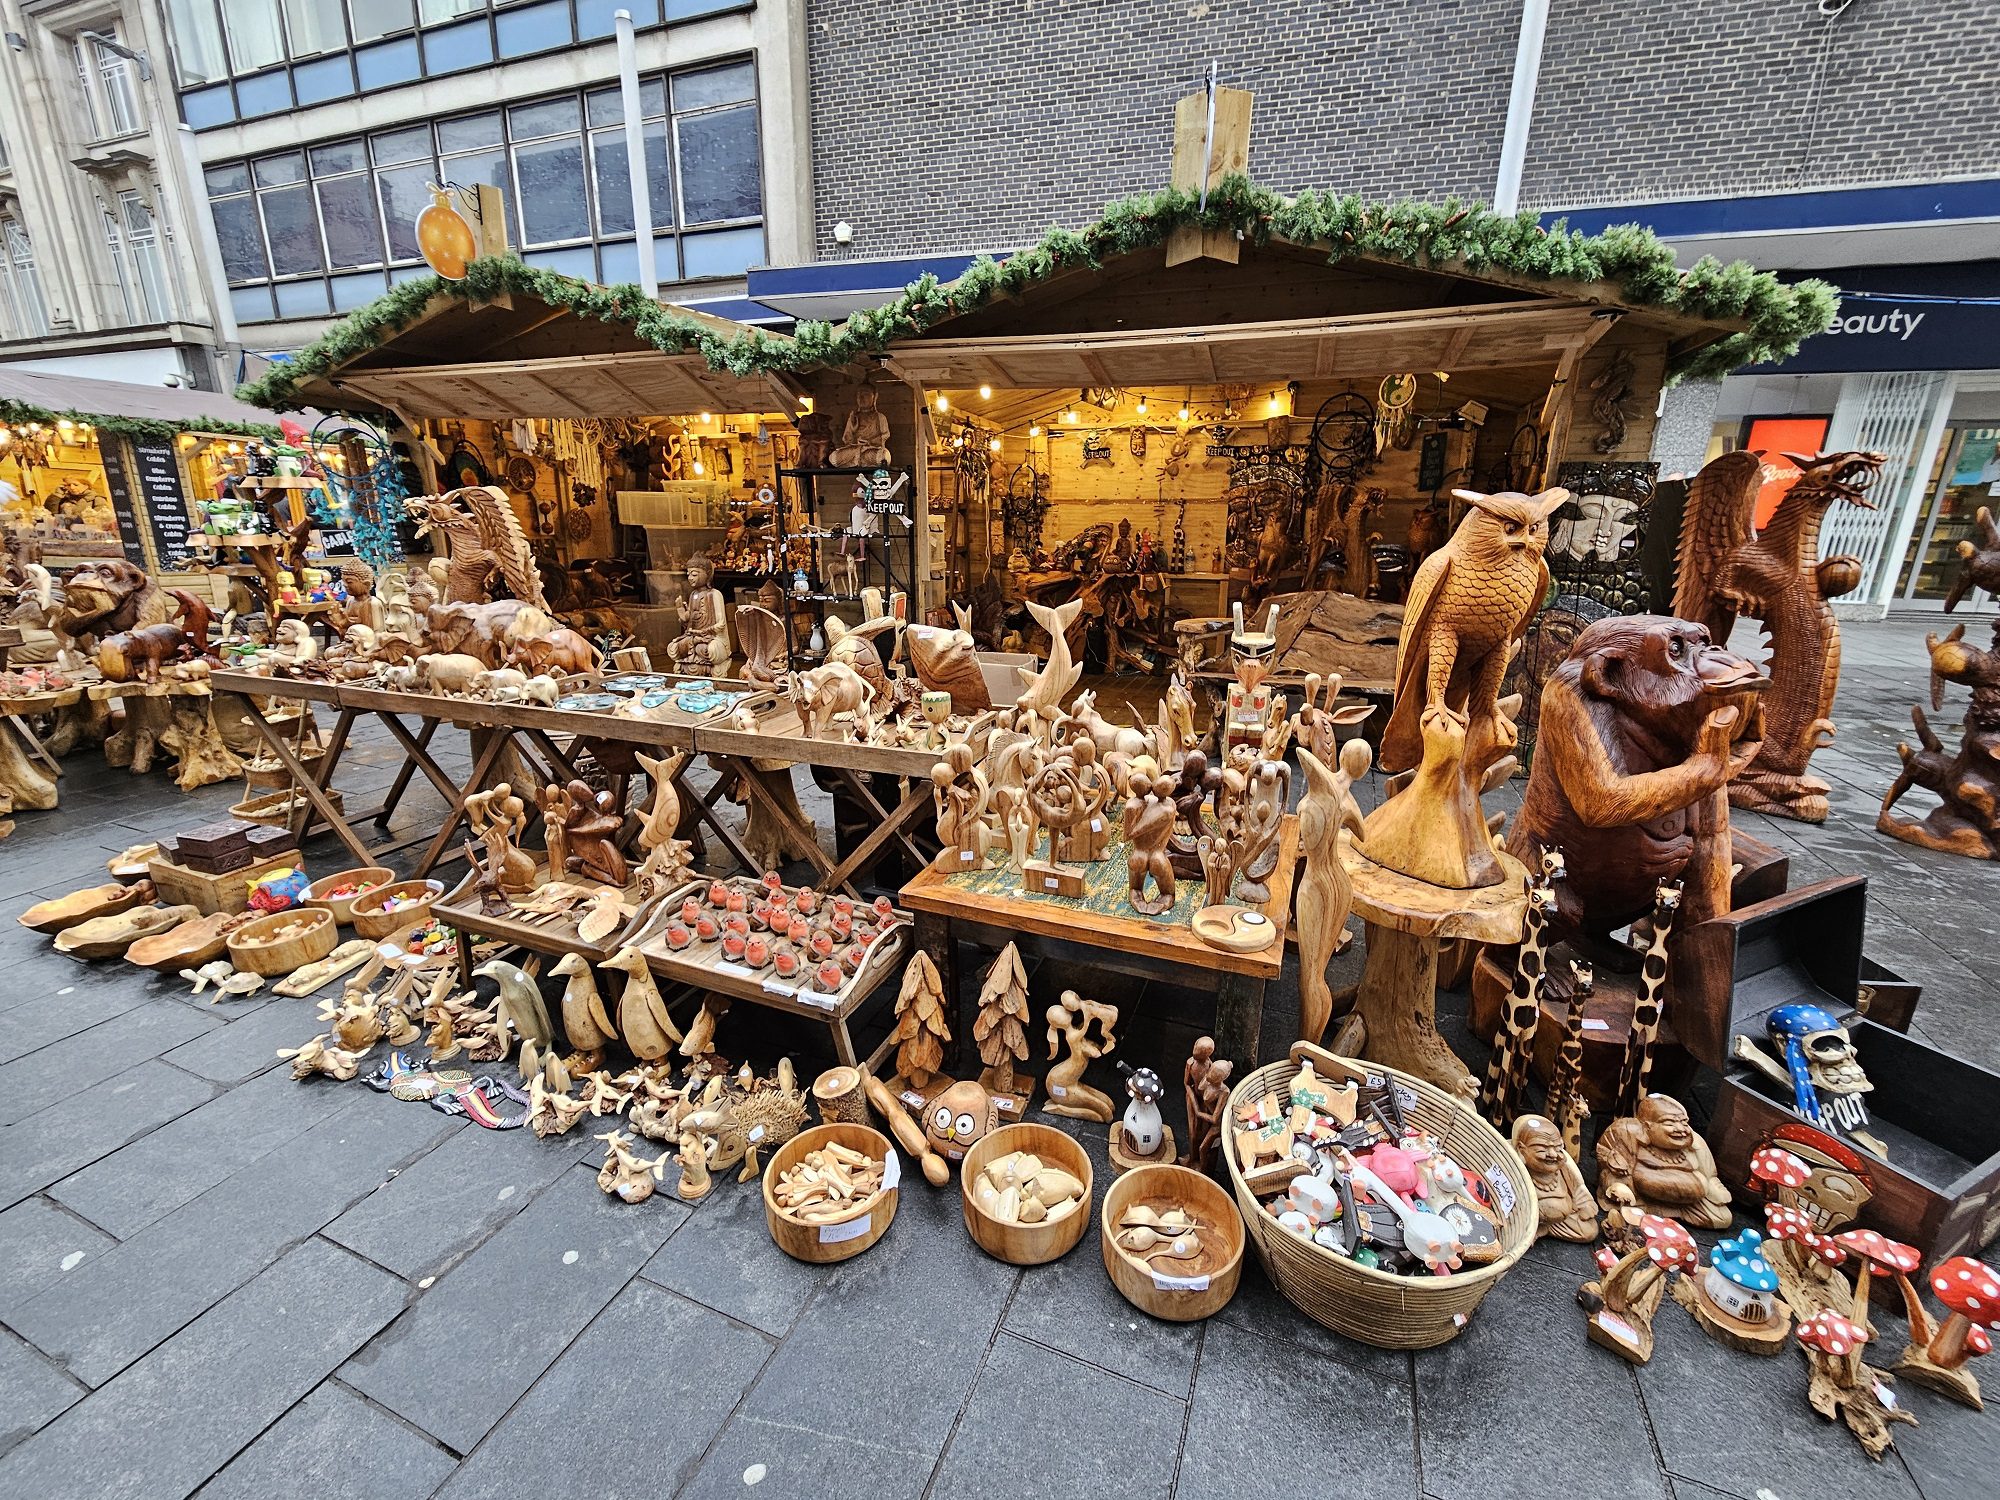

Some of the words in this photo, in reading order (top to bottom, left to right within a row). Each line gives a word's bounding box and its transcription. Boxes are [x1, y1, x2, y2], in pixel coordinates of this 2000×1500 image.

[1825, 308, 1925, 341] eauty
[1207, 447, 1222, 456] KEEP
[1223, 447, 1235, 456] OUT
[867, 500, 888, 513] KEEP
[889, 503, 904, 514] OUT
[1834, 1092, 1869, 1131] OUT
